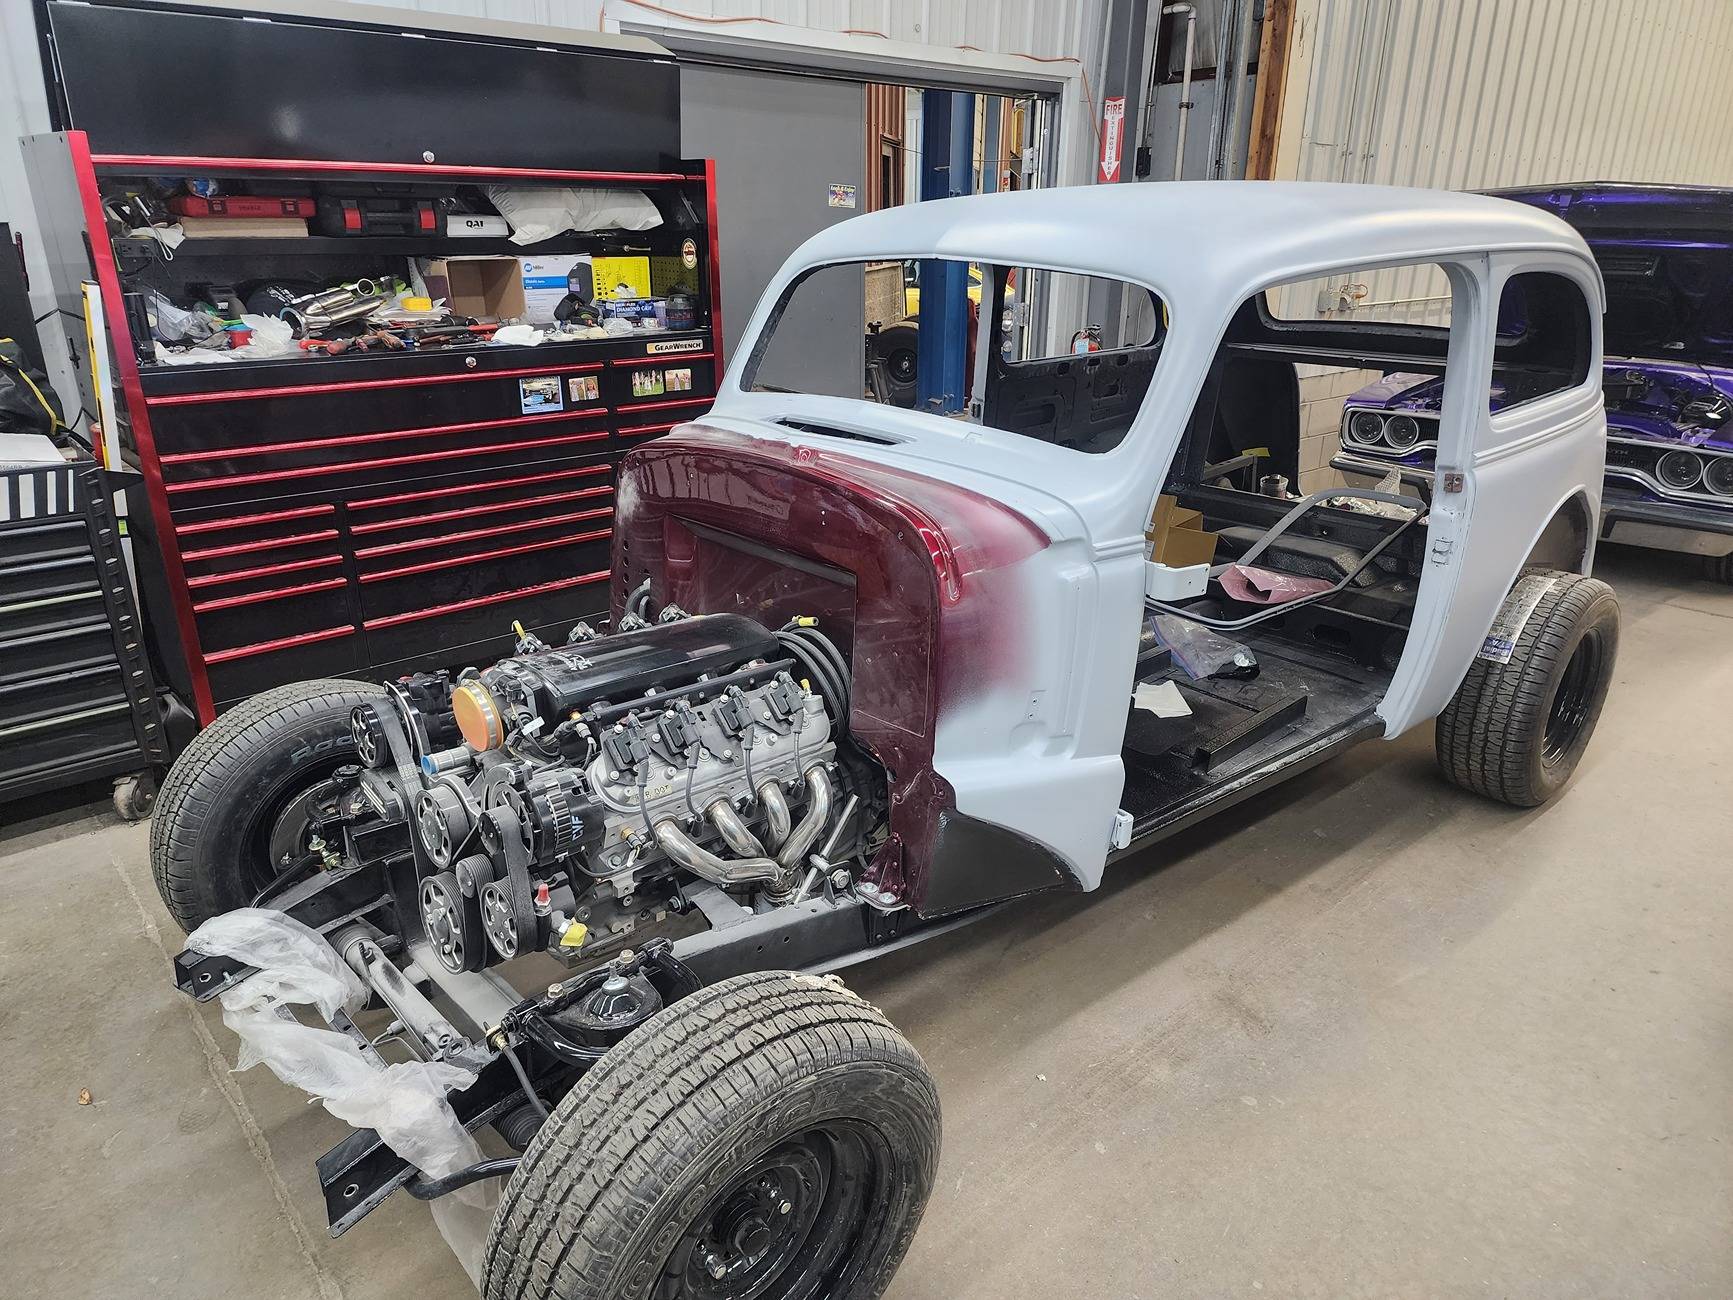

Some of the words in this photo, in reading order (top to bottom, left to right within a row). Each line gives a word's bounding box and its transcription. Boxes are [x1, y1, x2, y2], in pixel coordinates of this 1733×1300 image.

[1106, 103, 1123, 114] FIRE
[1106, 115, 1116, 176] EXTINGUISHER
[466, 220, 484, 228] QA1
[571, 815, 585, 841] CVF
